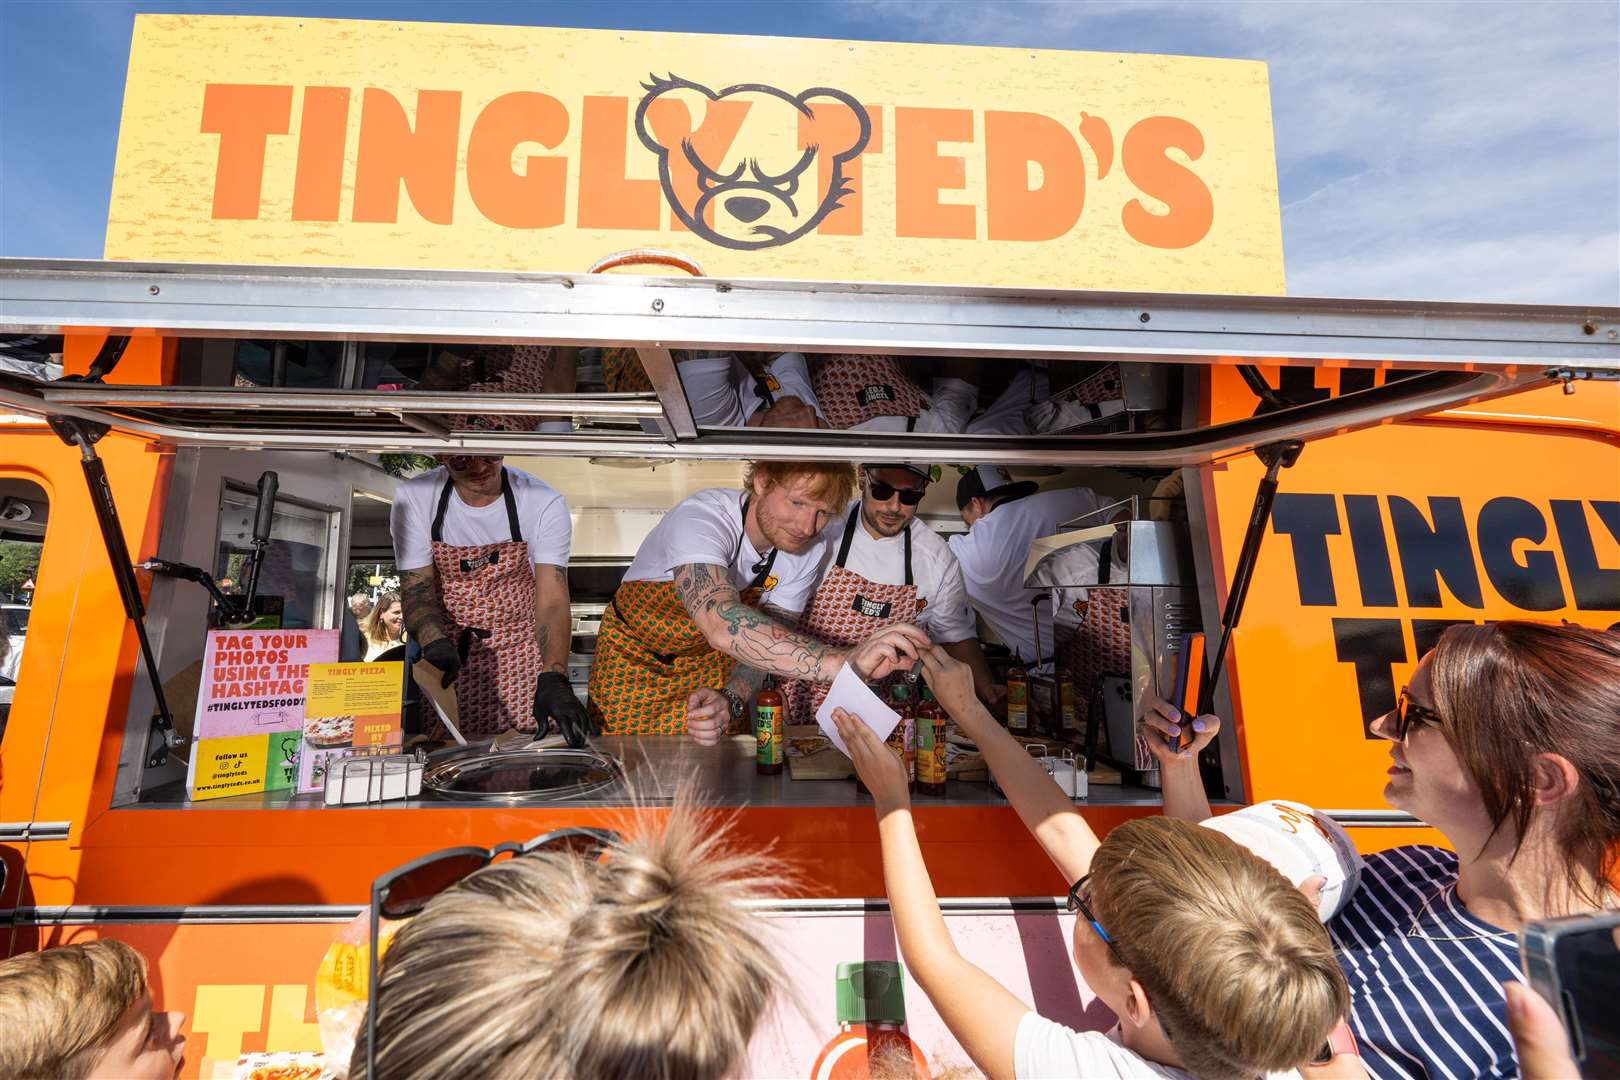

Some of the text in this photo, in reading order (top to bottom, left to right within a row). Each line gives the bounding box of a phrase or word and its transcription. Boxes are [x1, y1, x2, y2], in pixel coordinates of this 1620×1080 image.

[200, 83, 1214, 249] TINGLY TED'S
[215, 634, 308, 650] TAG YOUR
[214, 650, 288, 666] PHOTOS
[213, 664, 310, 682] USING THE
[327, 667, 386, 676] TINGLY PIZZA
[211, 679, 304, 699] HASHTAG
[215, 753, 238, 761] follow
